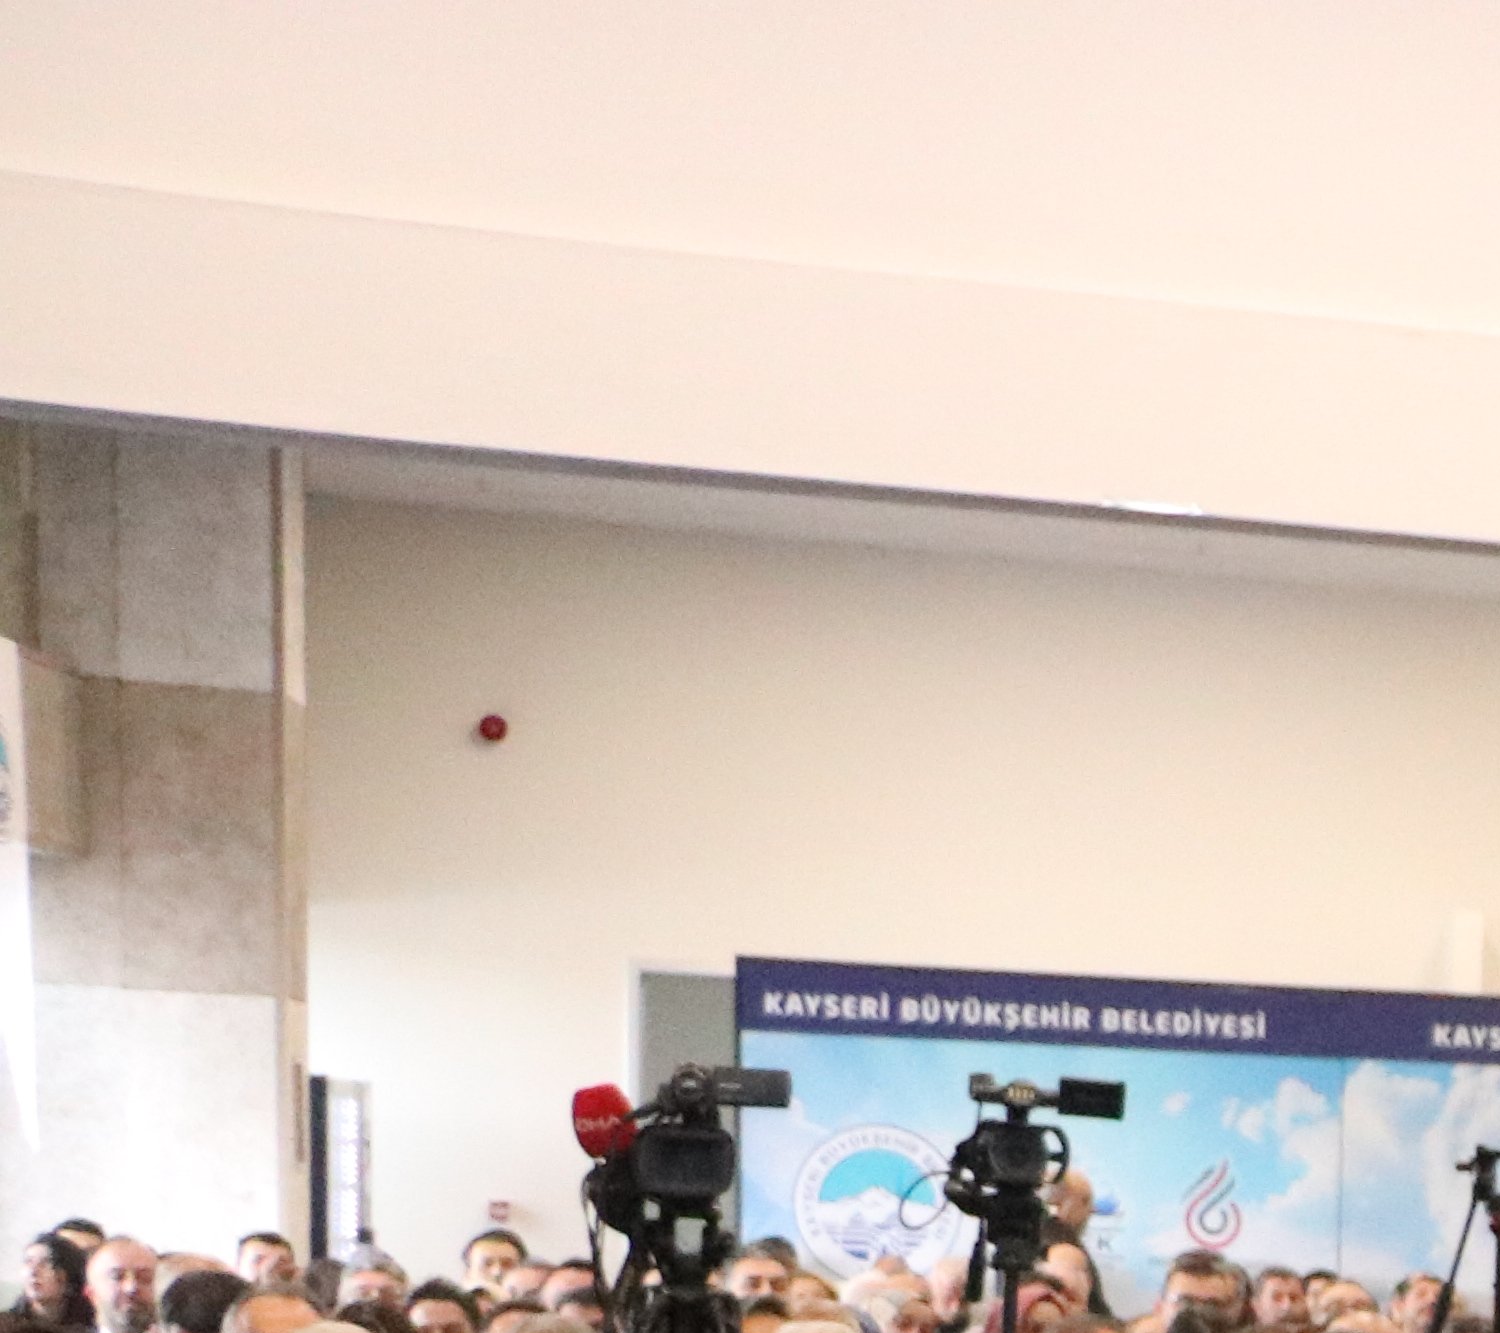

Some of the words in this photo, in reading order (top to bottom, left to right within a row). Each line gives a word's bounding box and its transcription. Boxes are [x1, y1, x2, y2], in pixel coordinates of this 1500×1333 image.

[763, 991, 890, 1020] KAYSERİ
[900, 993, 1091, 1031] BÜYÜKŞEHİR
[1100, 1006, 1267, 1040] BELEDİYESİ
